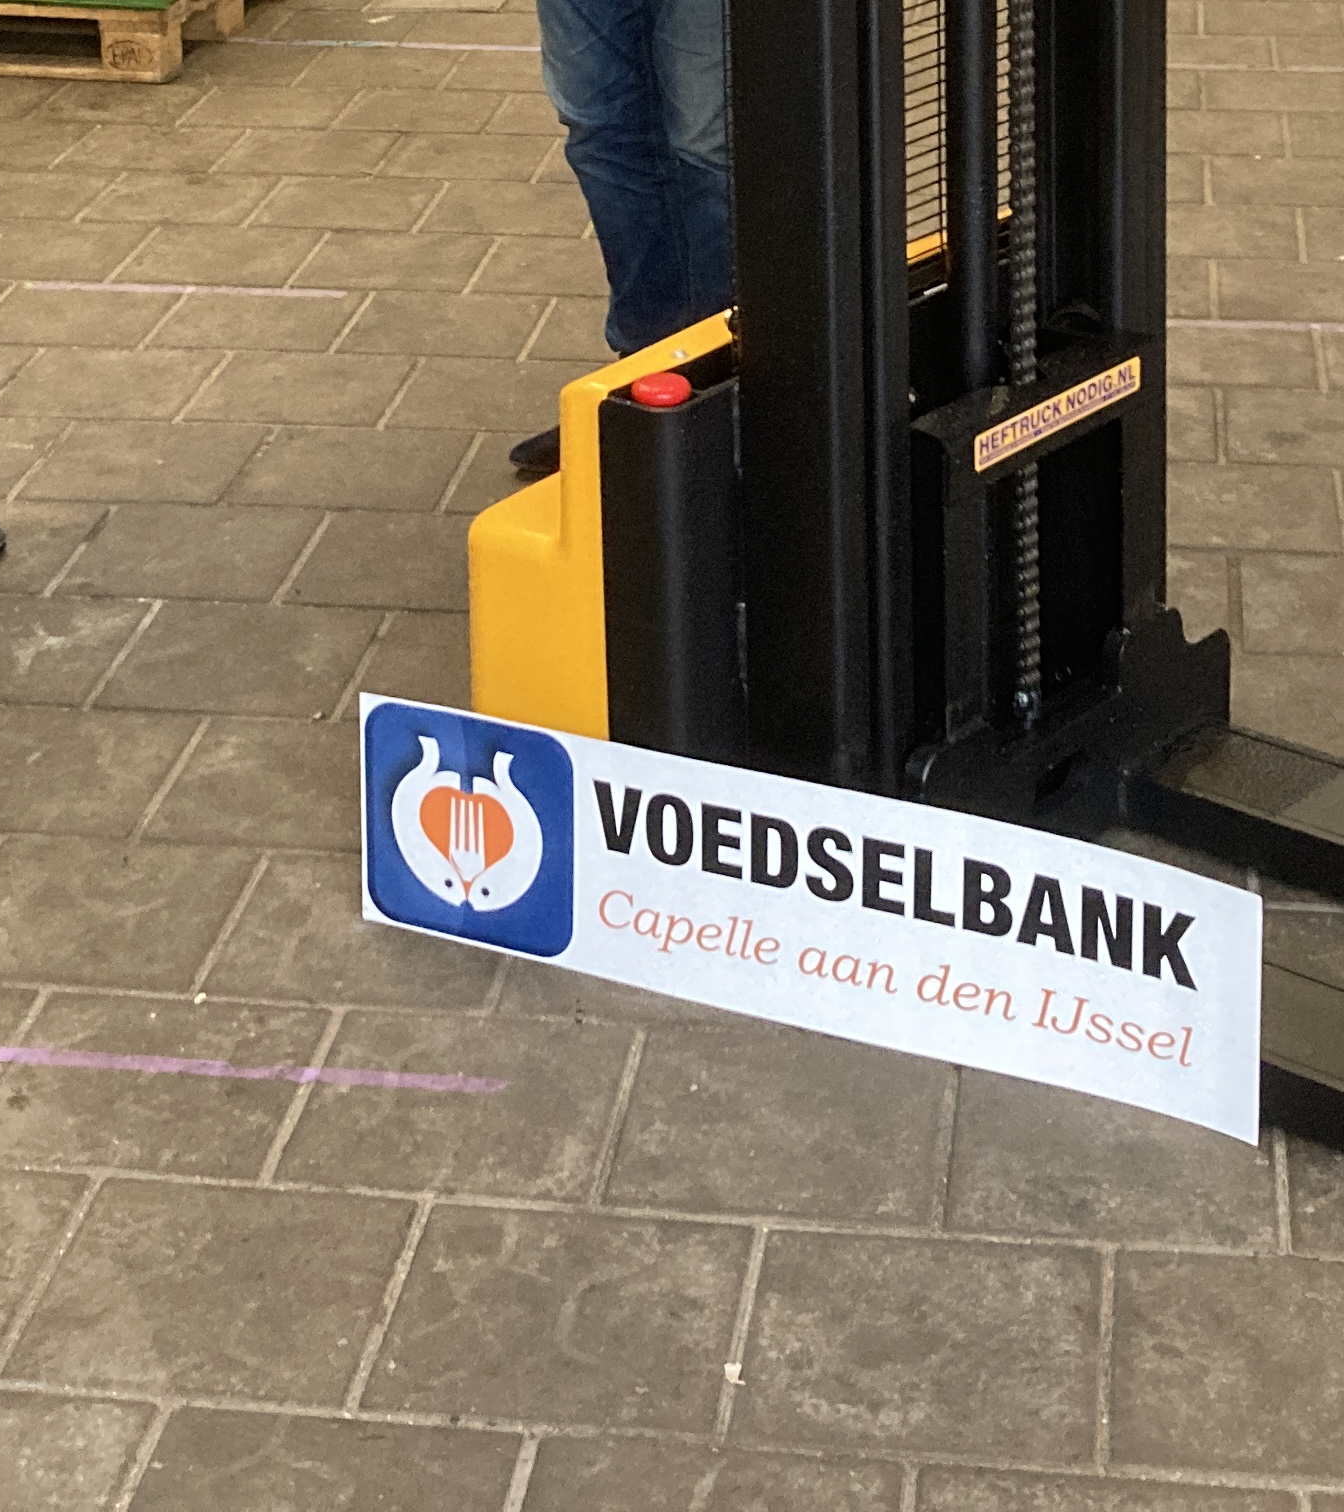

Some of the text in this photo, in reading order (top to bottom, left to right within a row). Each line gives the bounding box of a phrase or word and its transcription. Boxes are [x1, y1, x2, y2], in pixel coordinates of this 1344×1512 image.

[978, 399, 1063, 457] HEFTRUCK
[592, 778, 1198, 991] VOEDSELBANK
[598, 889, 1195, 1068] Capelle aan den IJssel
